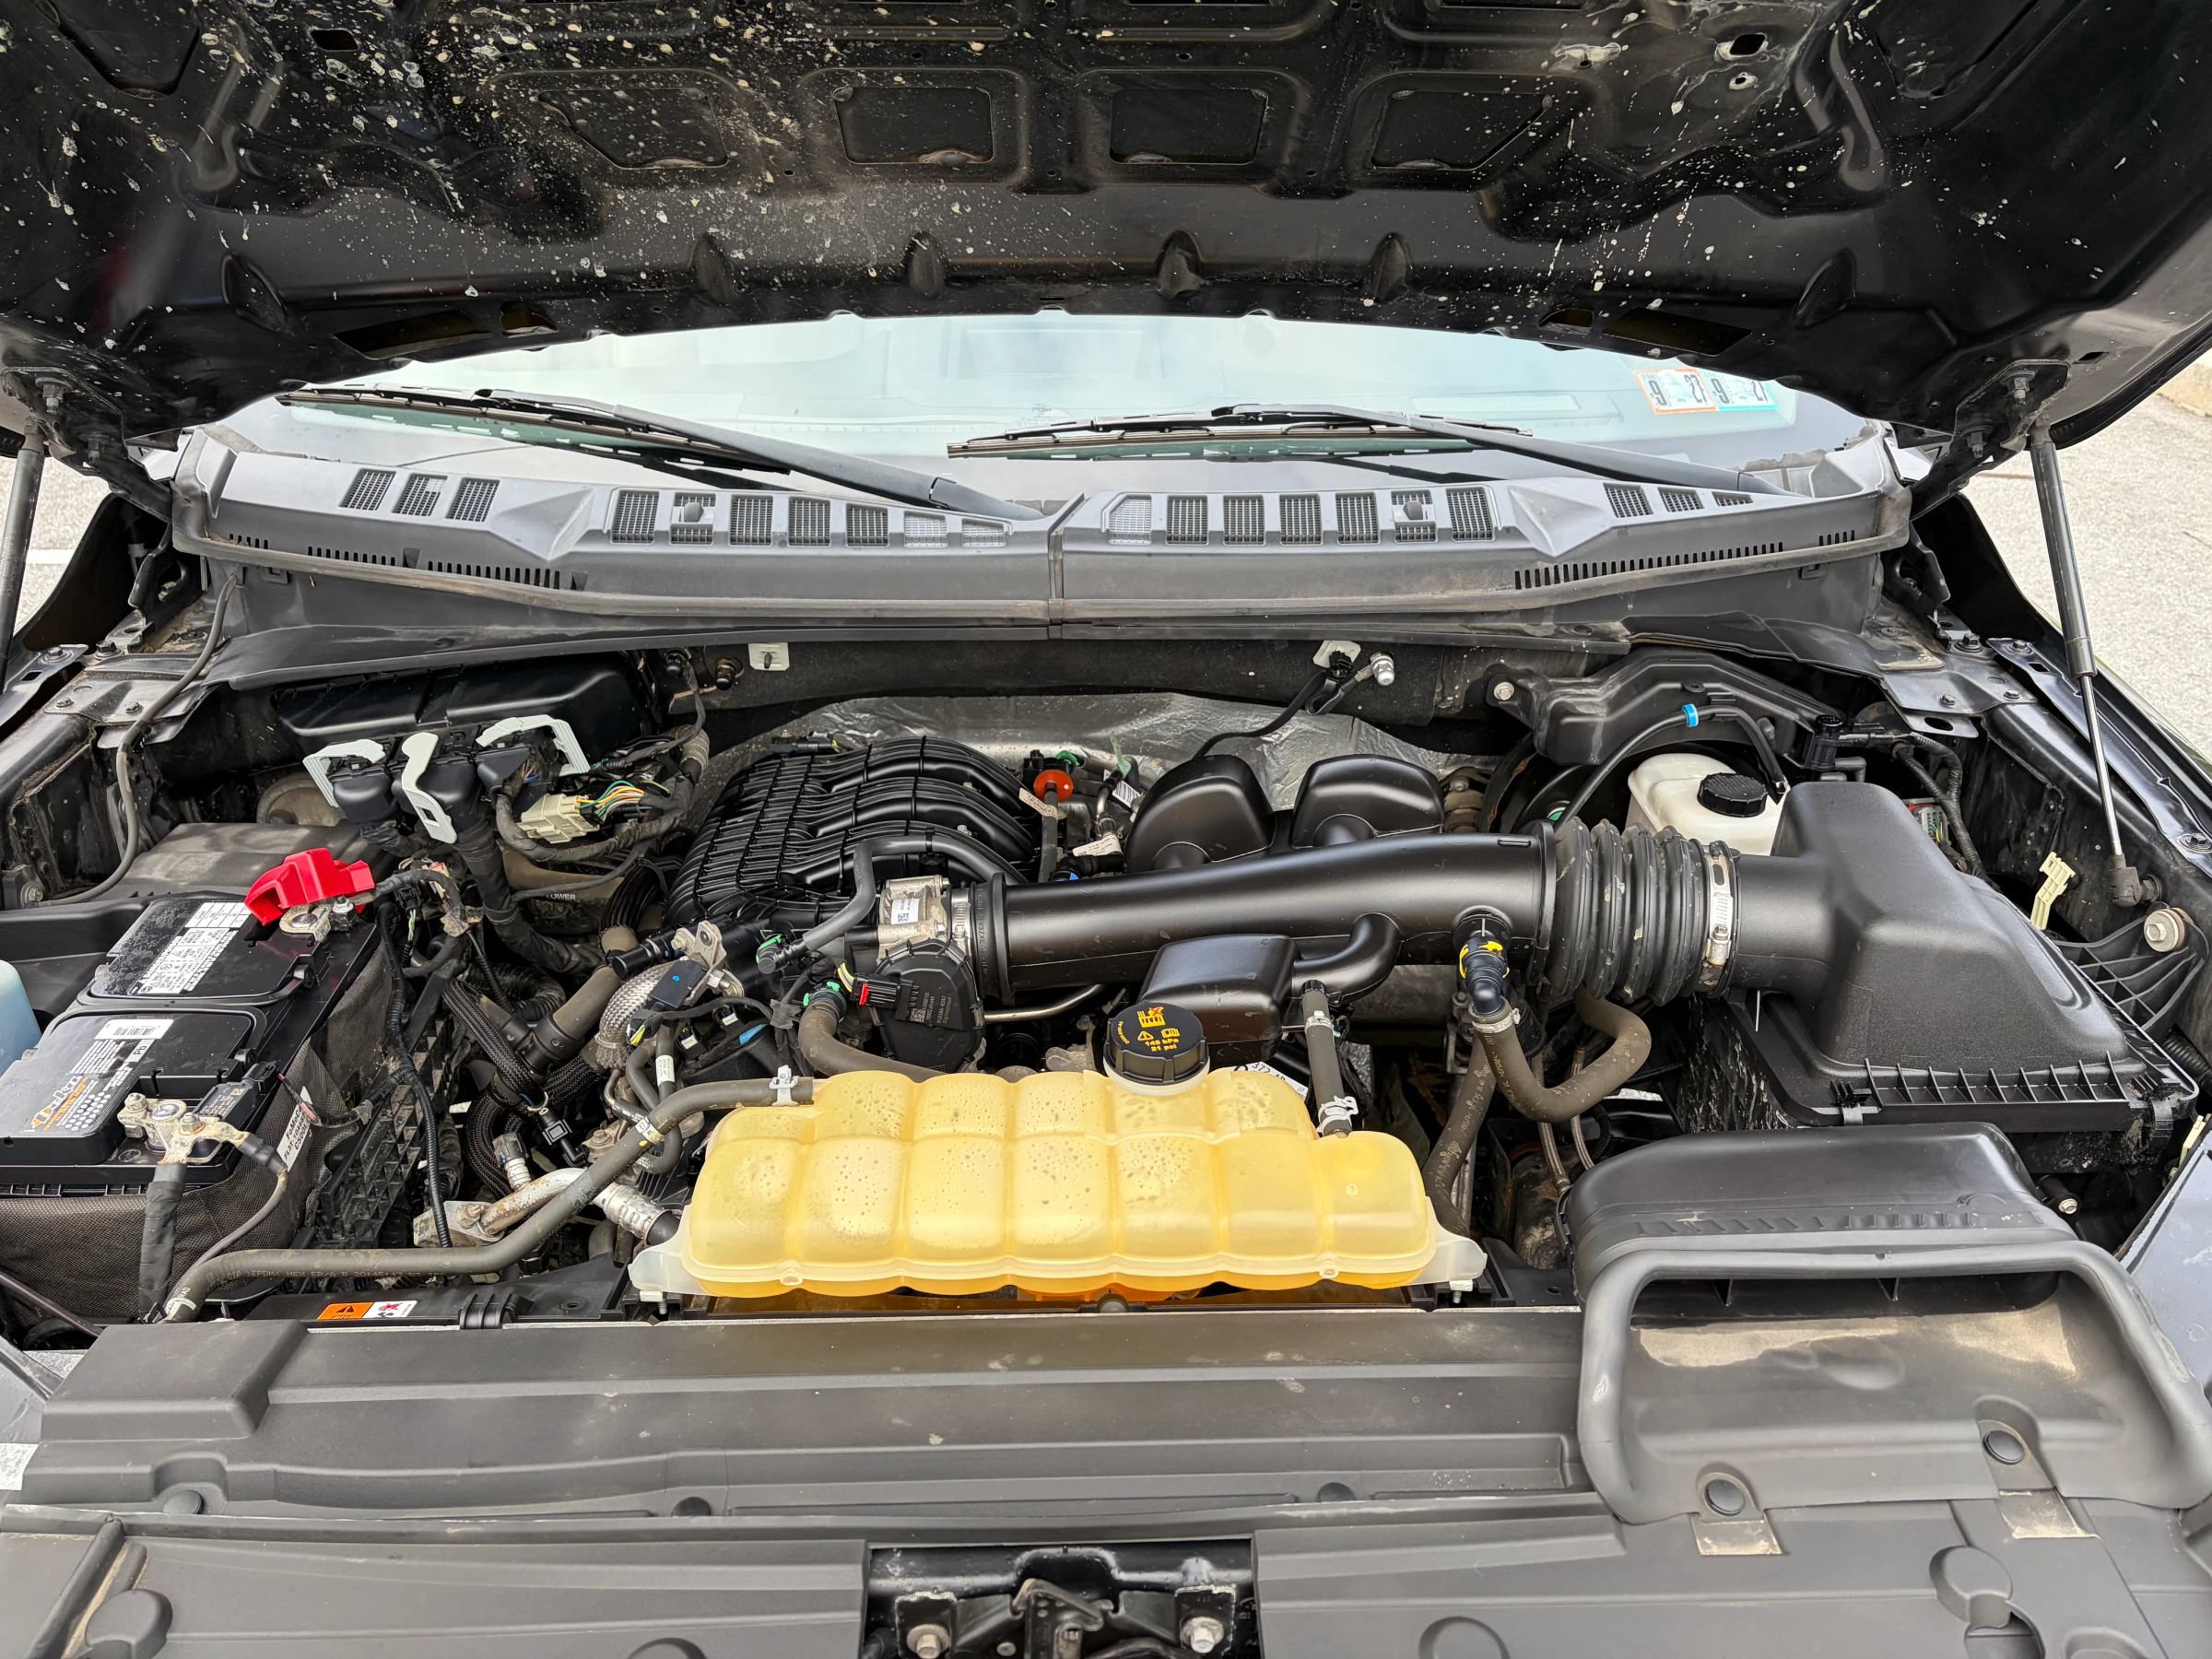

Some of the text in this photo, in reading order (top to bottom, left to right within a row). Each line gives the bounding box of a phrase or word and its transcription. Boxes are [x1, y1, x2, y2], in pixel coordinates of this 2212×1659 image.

[1648, 380, 1667, 406] 9
[1684, 373, 1708, 404] 27
[1711, 378, 1730, 404] 9
[133, 1045, 147, 1055] Pb
